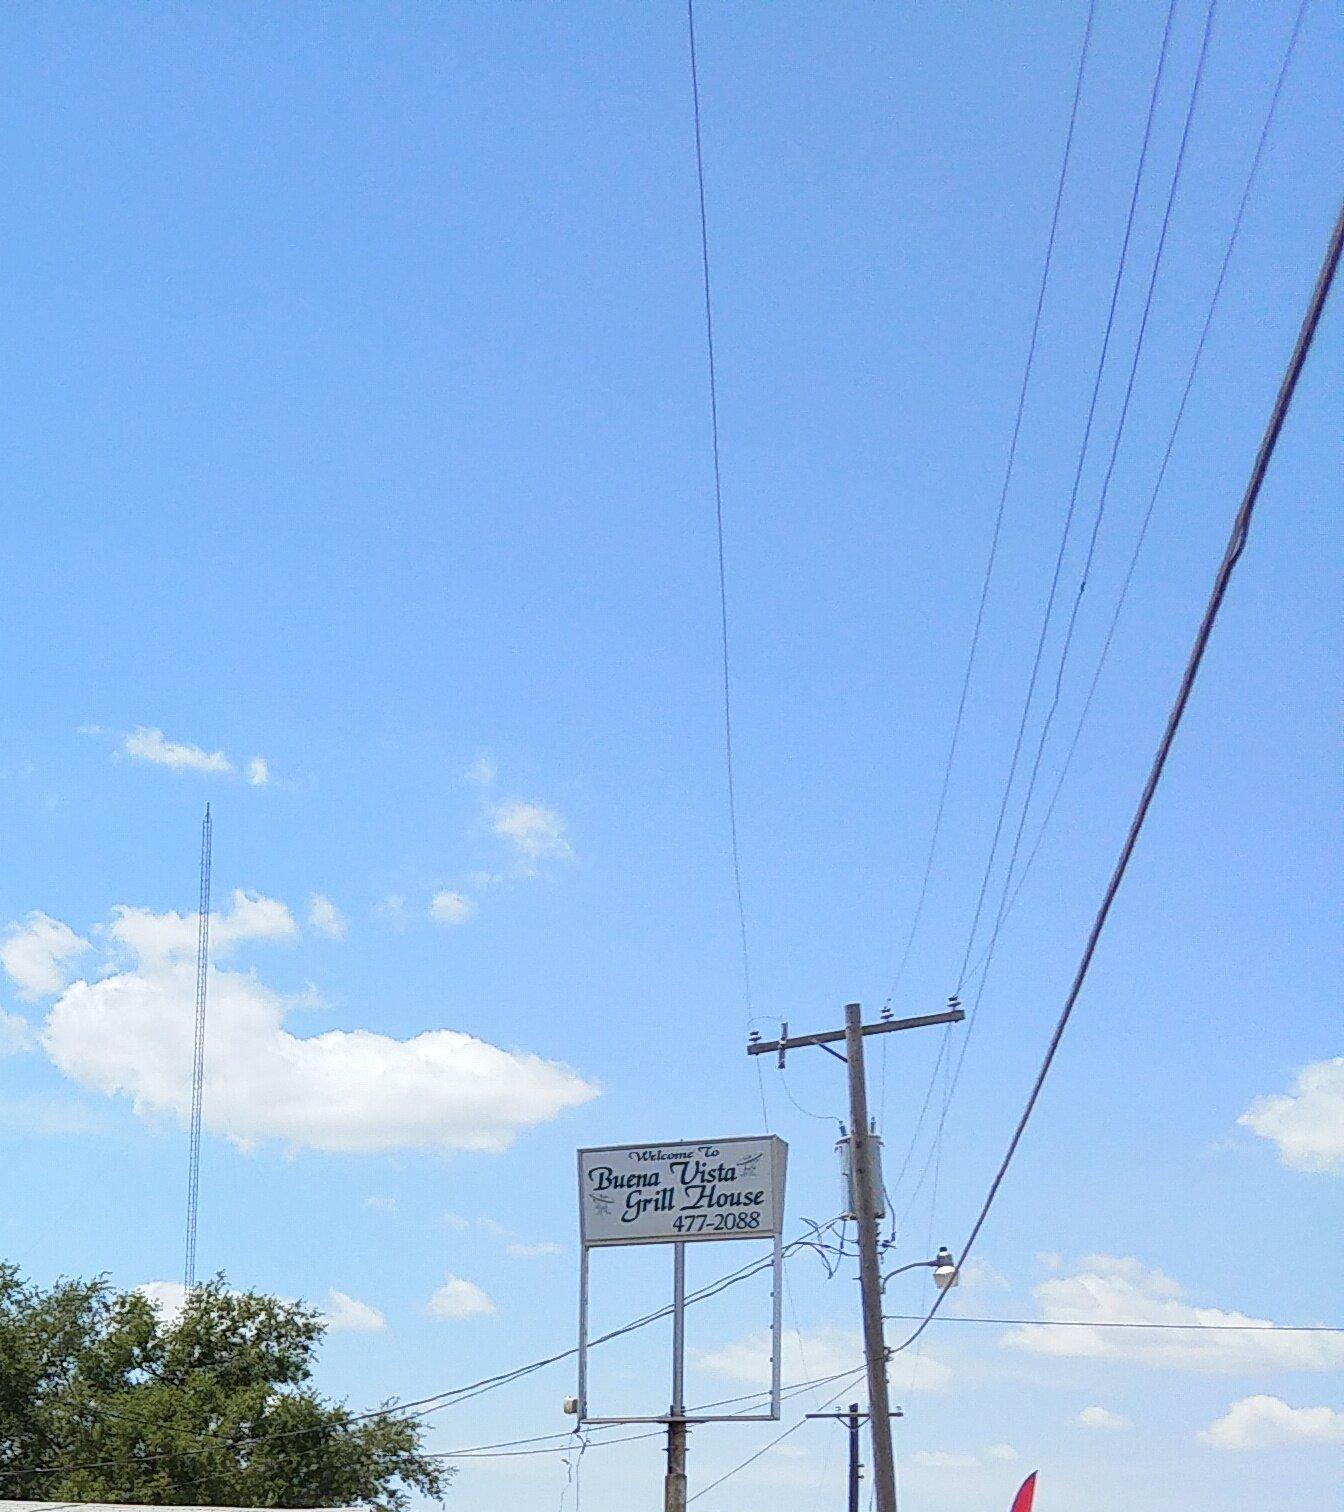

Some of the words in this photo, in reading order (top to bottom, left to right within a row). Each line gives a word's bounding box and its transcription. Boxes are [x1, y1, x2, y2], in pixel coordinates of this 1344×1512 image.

[628, 1150, 694, 1162] Welcome
[698, 1146, 720, 1158] To
[588, 1166, 661, 1191] Buena
[670, 1161, 738, 1186] Vista
[621, 1187, 675, 1223] Grill
[680, 1185, 765, 1211] House
[673, 1211, 761, 1232] 477-2088
